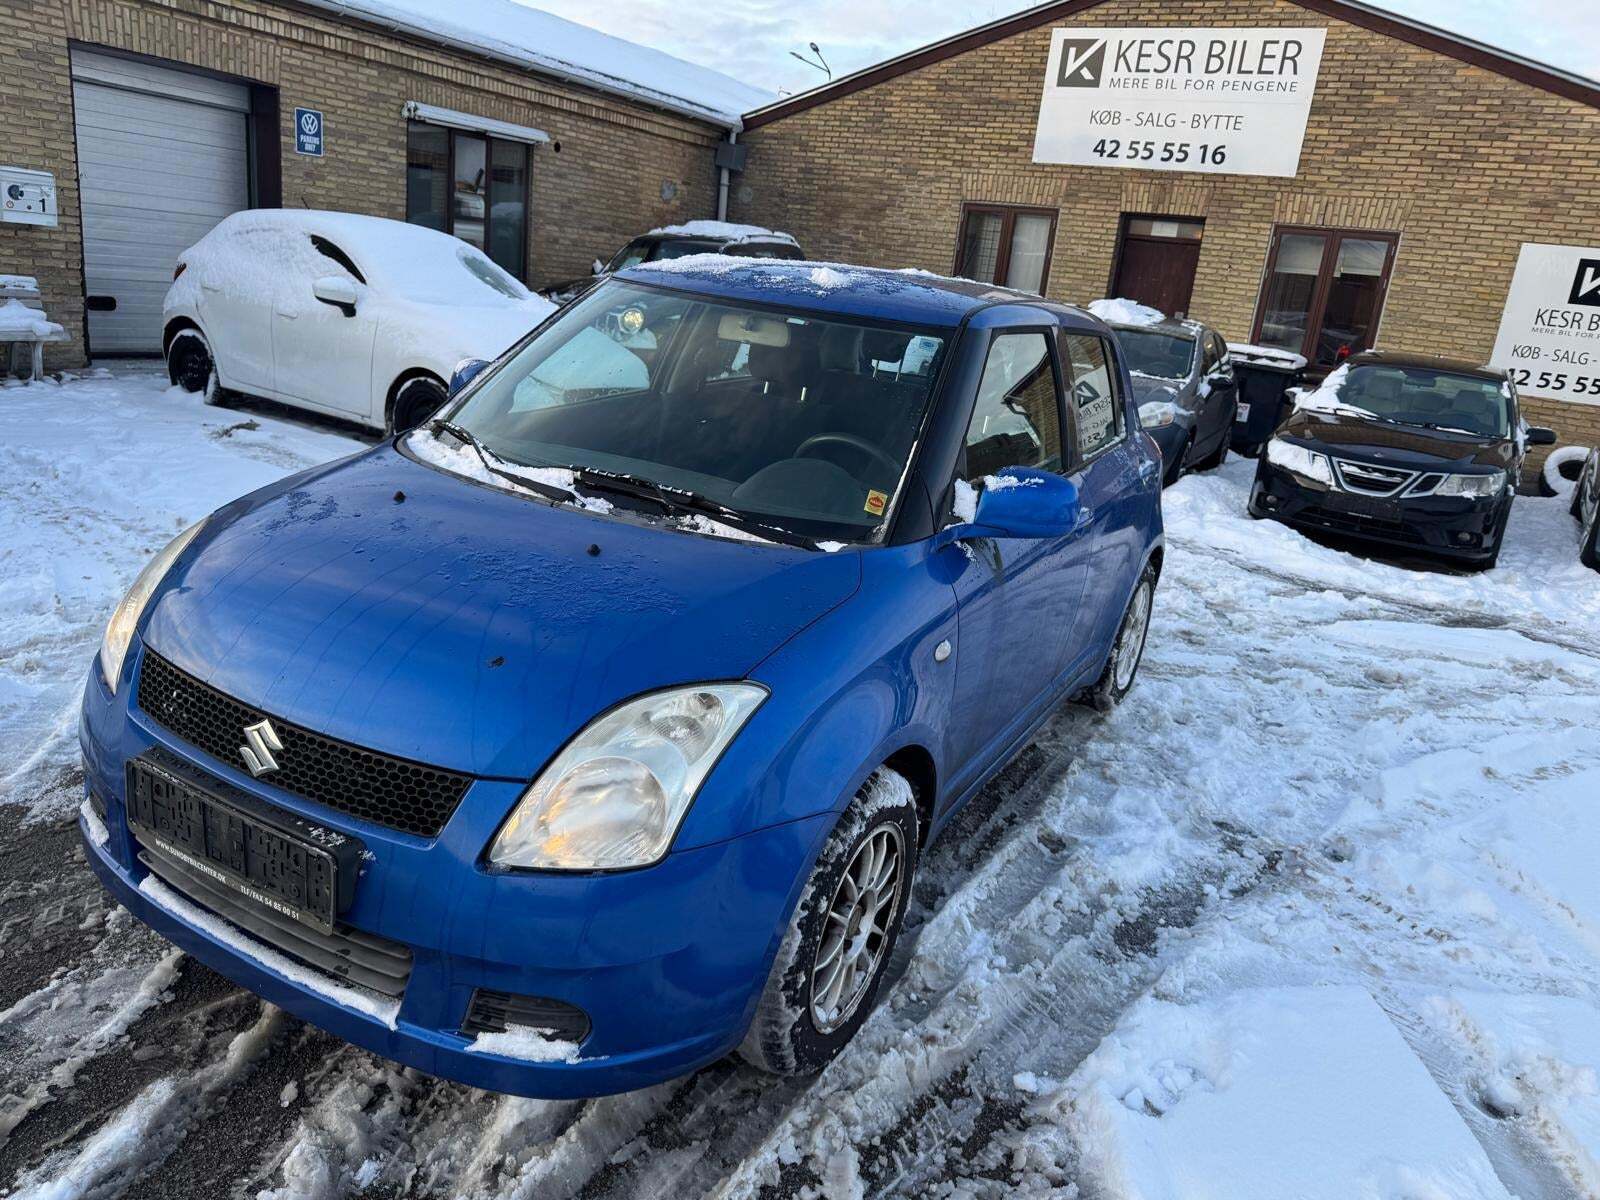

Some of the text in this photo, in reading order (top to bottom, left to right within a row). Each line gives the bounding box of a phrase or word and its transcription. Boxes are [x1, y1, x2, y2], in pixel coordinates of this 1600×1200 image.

[1113, 39, 1303, 76] KESR BILER
[1109, 77, 1299, 93] MERE BIL FOR PENGENE
[1089, 109, 1122, 126] KØB
[1134, 111, 1177, 129] SALG
[1190, 112, 1244, 131] BYTTE
[1092, 138, 1227, 165] 42 55 55 16
[1534, 308, 1584, 331] KESR
[1531, 326, 1556, 336] MERE
[1558, 329, 1572, 337] BIL
[1575, 331, 1594, 339] FOR
[1512, 343, 1541, 360] KØB
[1552, 349, 1590, 366] SALG
[1536, 372, 1567, 391] 55
[1573, 376, 1600, 396] 55
